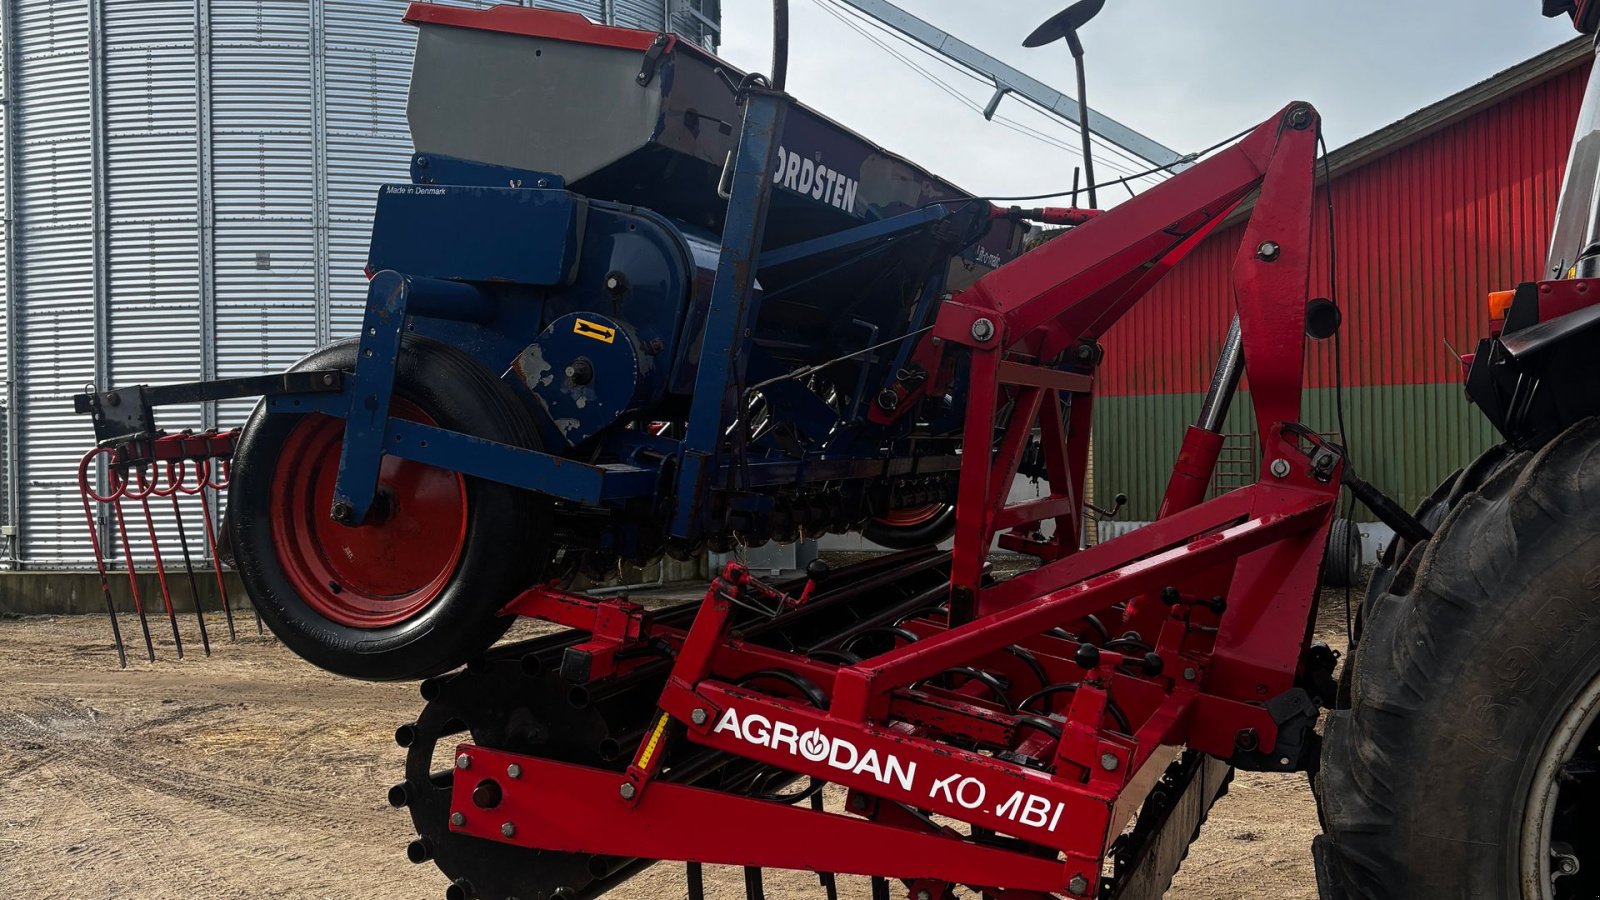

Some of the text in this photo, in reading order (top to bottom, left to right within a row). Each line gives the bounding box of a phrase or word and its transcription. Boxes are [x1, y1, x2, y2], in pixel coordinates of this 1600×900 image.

[386, 186, 405, 194] Made
[415, 187, 446, 195] Denmark
[714, 708, 917, 791] AGRODAN
